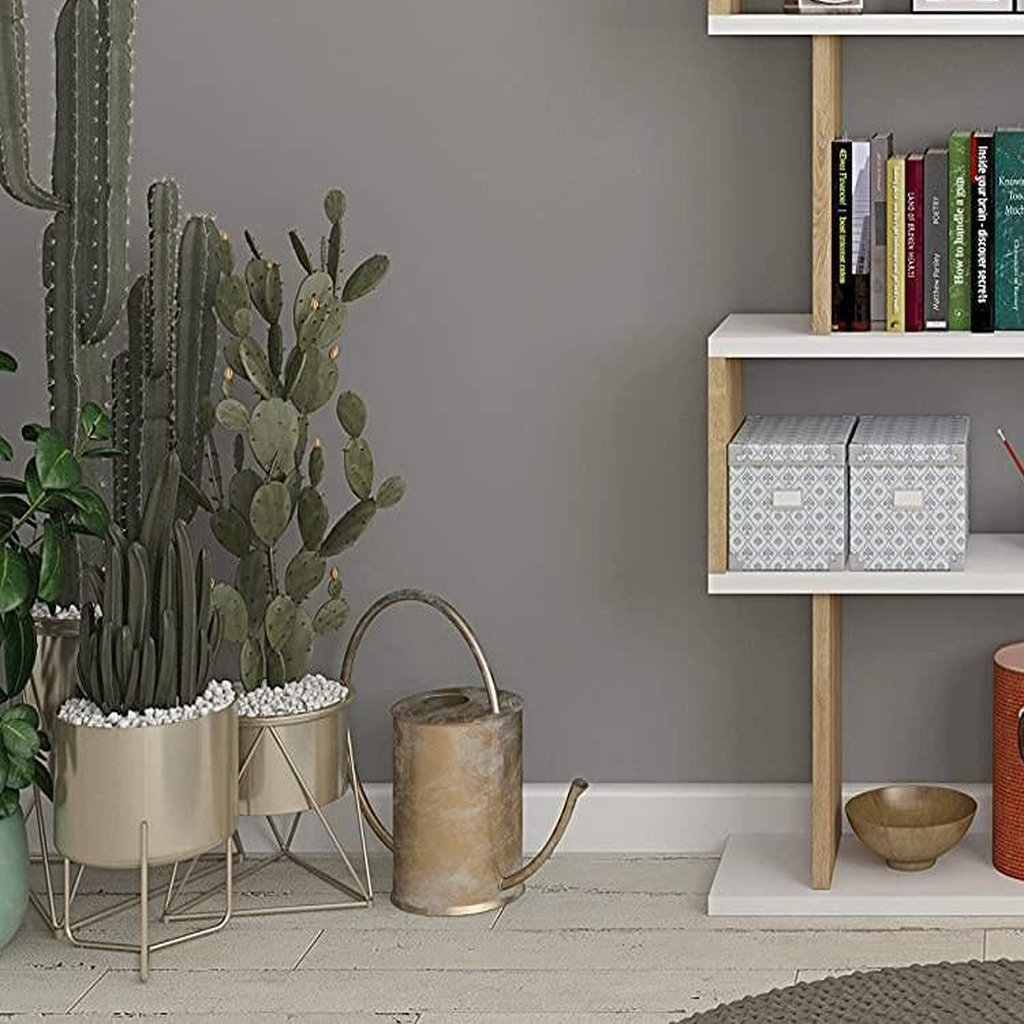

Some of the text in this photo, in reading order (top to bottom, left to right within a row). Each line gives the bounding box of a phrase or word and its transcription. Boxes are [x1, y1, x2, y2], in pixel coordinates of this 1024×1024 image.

[954, 208, 965, 244] handle
[975, 145, 989, 304] Inside your brain discover secrets
[955, 246, 964, 258] to
[954, 260, 964, 285] How
